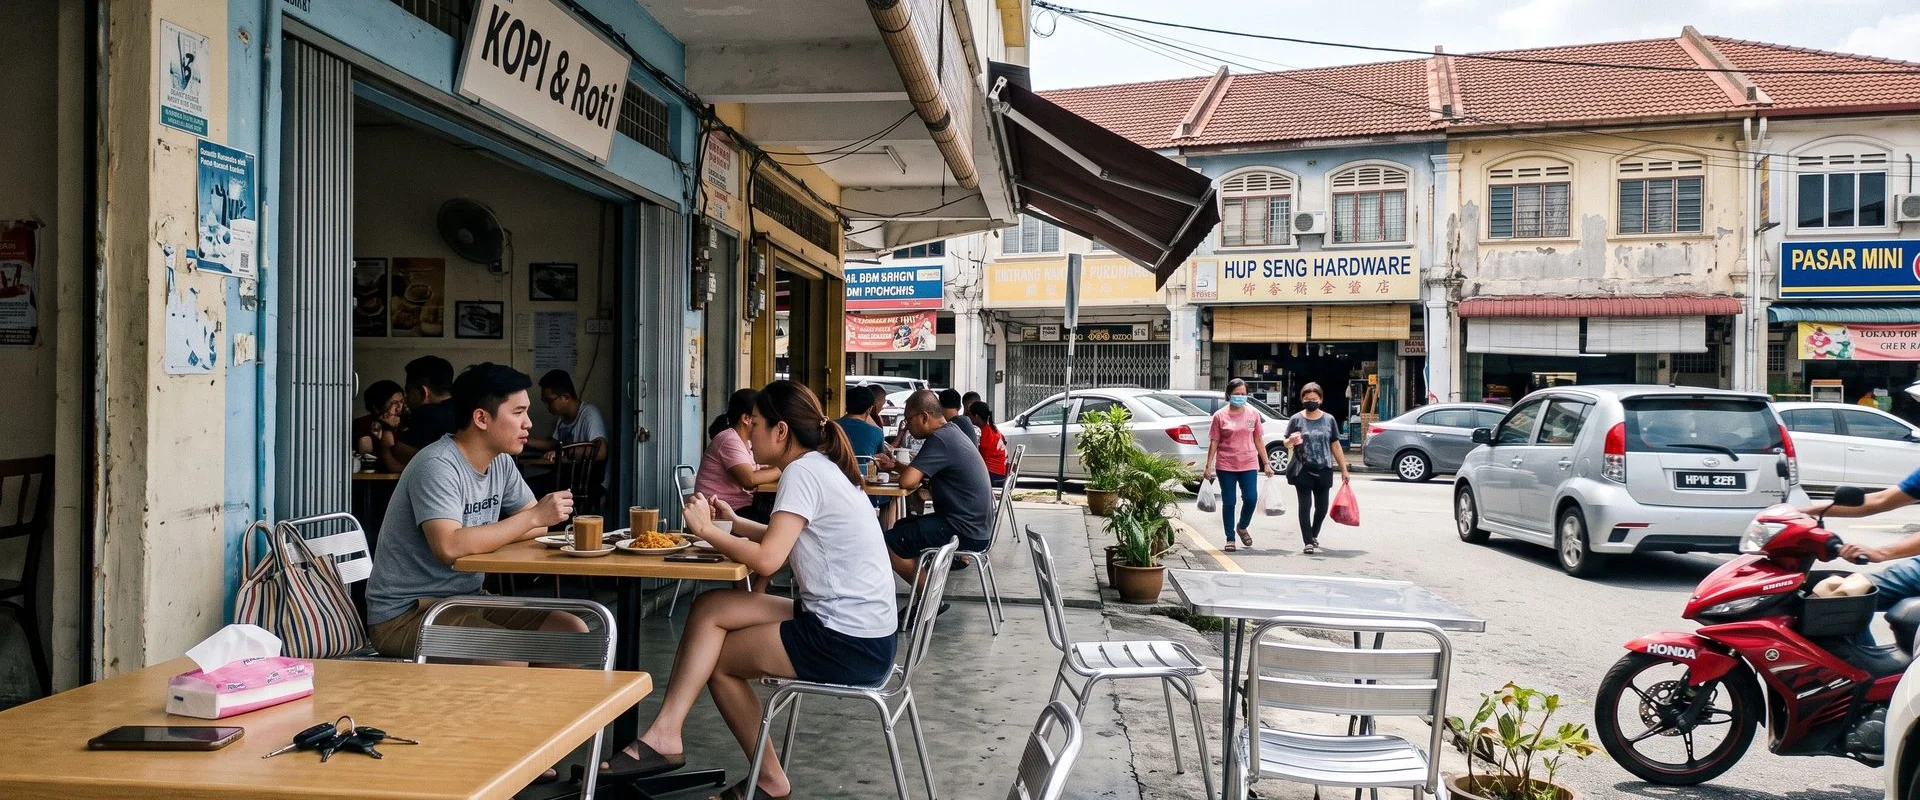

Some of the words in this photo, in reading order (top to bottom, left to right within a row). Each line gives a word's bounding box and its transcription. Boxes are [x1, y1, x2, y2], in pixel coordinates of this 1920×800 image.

[481, 4, 551, 91] KOPI
[549, 50, 570, 105] &
[570, 62, 617, 129] Roti
[1224, 260, 1257, 279] HUP
[1262, 258, 1308, 278] SENG
[1313, 255, 1412, 277] HARDWARE
[1792, 248, 1857, 270] PASAR
[1862, 247, 1903, 269] MINI
[1646, 643, 1697, 660] HONDA
